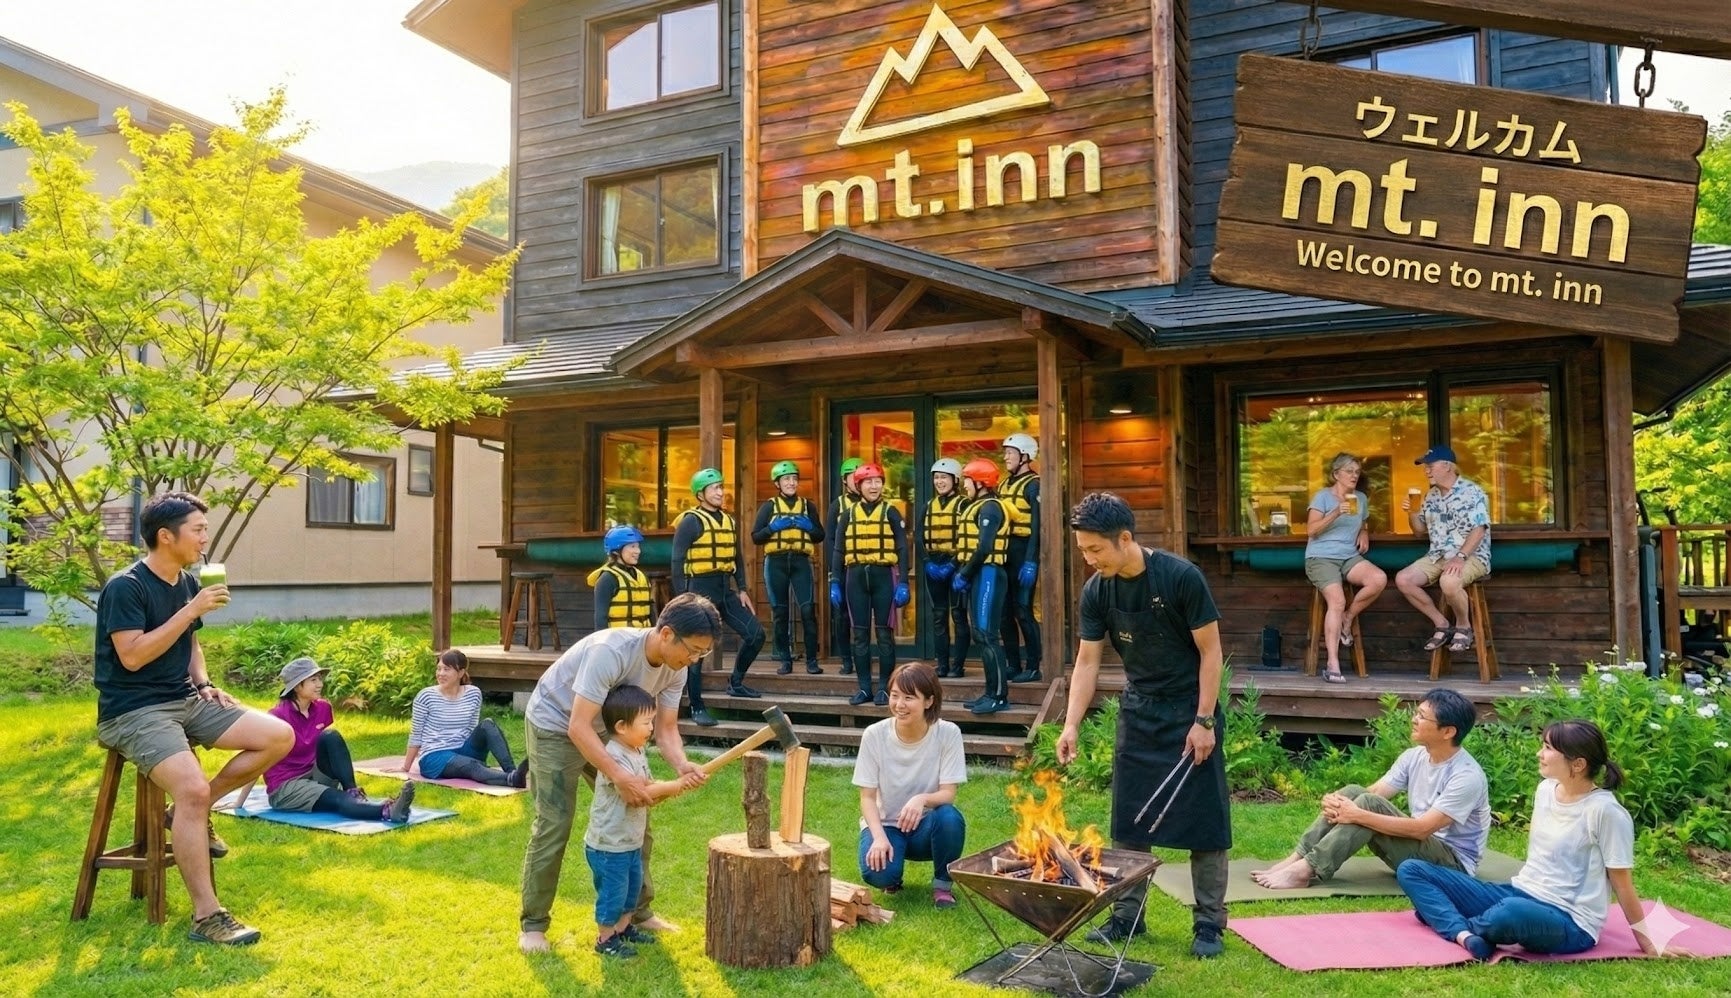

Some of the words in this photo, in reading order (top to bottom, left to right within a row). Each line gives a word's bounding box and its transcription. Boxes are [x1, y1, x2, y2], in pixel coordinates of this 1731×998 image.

[1355, 96, 1582, 165] ウェルカム
[1281, 158, 1438, 238] mt.
[1472, 166, 1630, 263] inn
[1296, 239, 1442, 285] Welcome
[1449, 261, 1482, 290] to
[1490, 269, 1542, 298] mt.
[1552, 272, 1603, 305] inn
